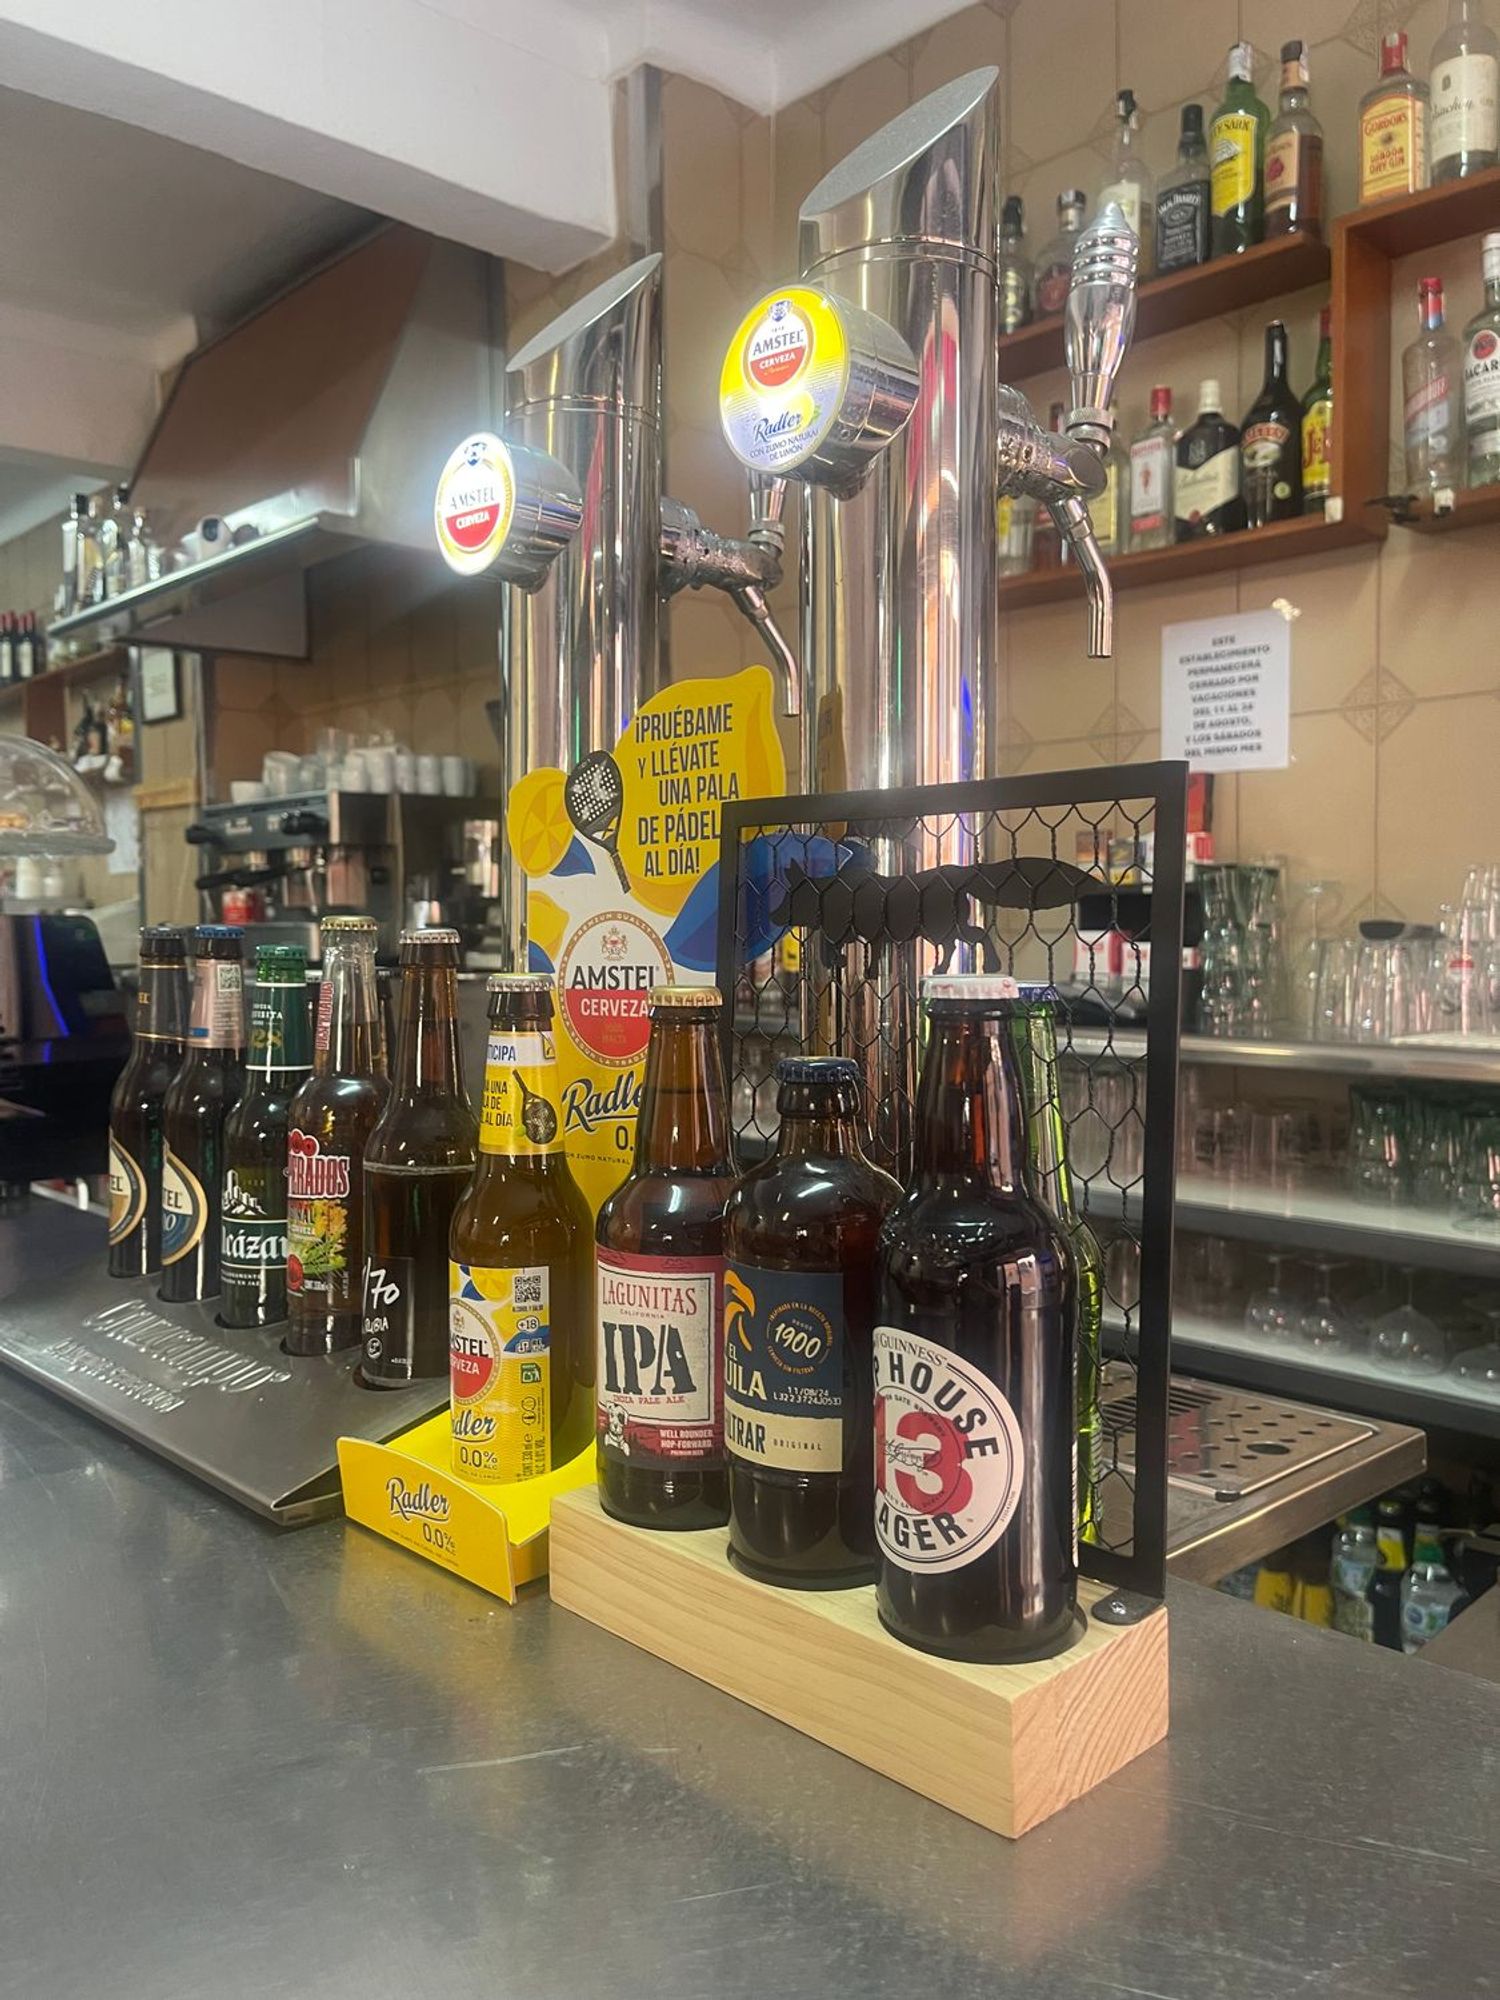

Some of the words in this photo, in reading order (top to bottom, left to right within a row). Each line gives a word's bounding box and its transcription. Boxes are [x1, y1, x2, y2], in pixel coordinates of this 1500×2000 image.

[752, 329, 804, 356] AMSTEL
[758, 352, 796, 370] CERVEZA
[752, 411, 803, 444] Radler
[764, 439, 788, 455] ZUMO
[450, 487, 496, 510] AMSTEL
[1191, 689, 1256, 704] VACACIONES
[638, 757, 646, 779] Y
[651, 740, 720, 778] LLÉVATE
[659, 777, 691, 807] UNA
[697, 772, 739, 802] PALA
[638, 816, 659, 846] DE
[665, 809, 721, 844] PÁDEL
[644, 850, 665, 878] AL
[668, 847, 700, 876] DÍA!
[581, 997, 648, 1018] CERVEZA
[491, 1080, 508, 1095] UNA
[491, 1097, 502, 1109] DE
[496, 1112, 513, 1127] DÍA
[616, 1125, 634, 1151] 0.
[602, 1276, 698, 1317] LAGUNITAS
[619, 1308, 665, 1319] CALIFORNIA
[728, 1342, 738, 1361] EL
[774, 1323, 822, 1359] 1900
[879, 1332, 945, 1367] GUINNESS
[602, 1321, 698, 1396] IPA
[613, 1394, 635, 1405] INDIA
[639, 1396, 661, 1405] PALE
[666, 1395, 686, 1404] ALE
[888, 1352, 1001, 1460] HOUSE
[660, 1429, 679, 1439] WELL
[773, 1438, 823, 1451] ORIGINAL
[460, 1446, 498, 1468] 0.0%
[385, 1476, 451, 1523] Radler
[422, 1522, 456, 1551] 0.0%
[878, 1508, 969, 1552] AGER
